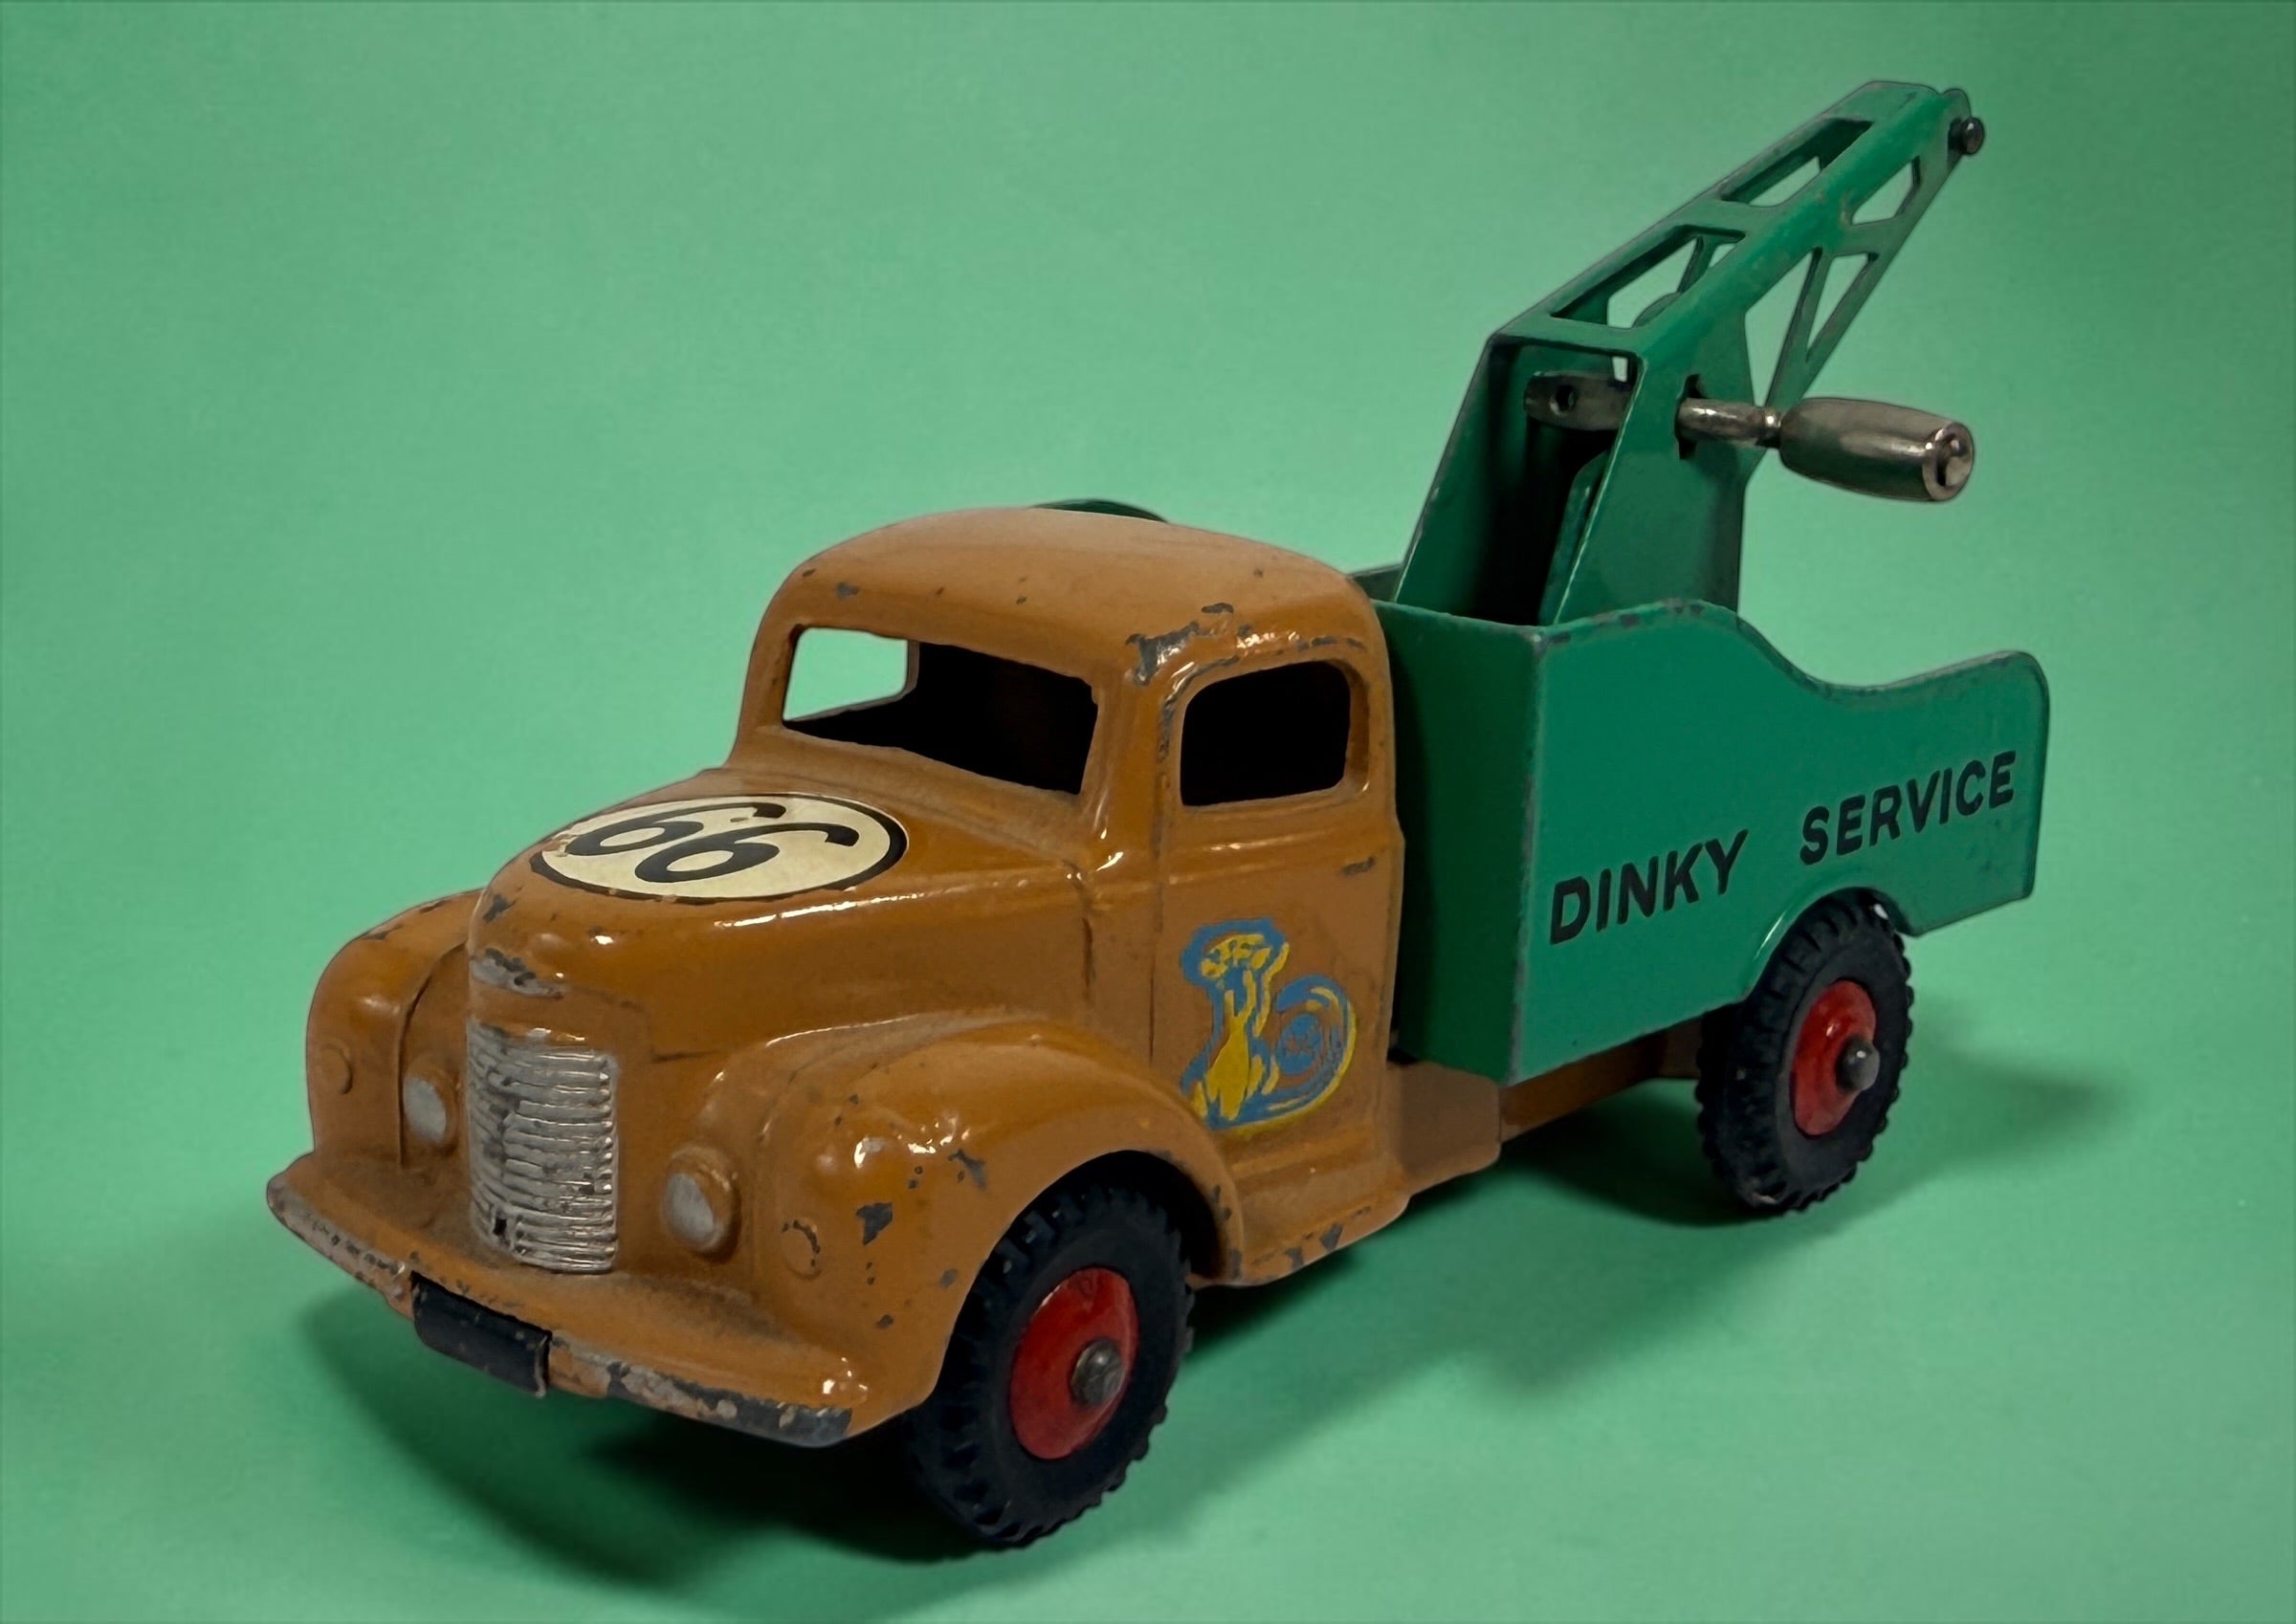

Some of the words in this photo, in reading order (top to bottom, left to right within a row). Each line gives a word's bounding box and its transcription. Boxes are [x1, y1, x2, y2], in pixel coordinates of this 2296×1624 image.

[564, 801, 860, 883] 66
[1549, 828, 1749, 945] DINKY
[1799, 750, 2017, 865] SERVICE
